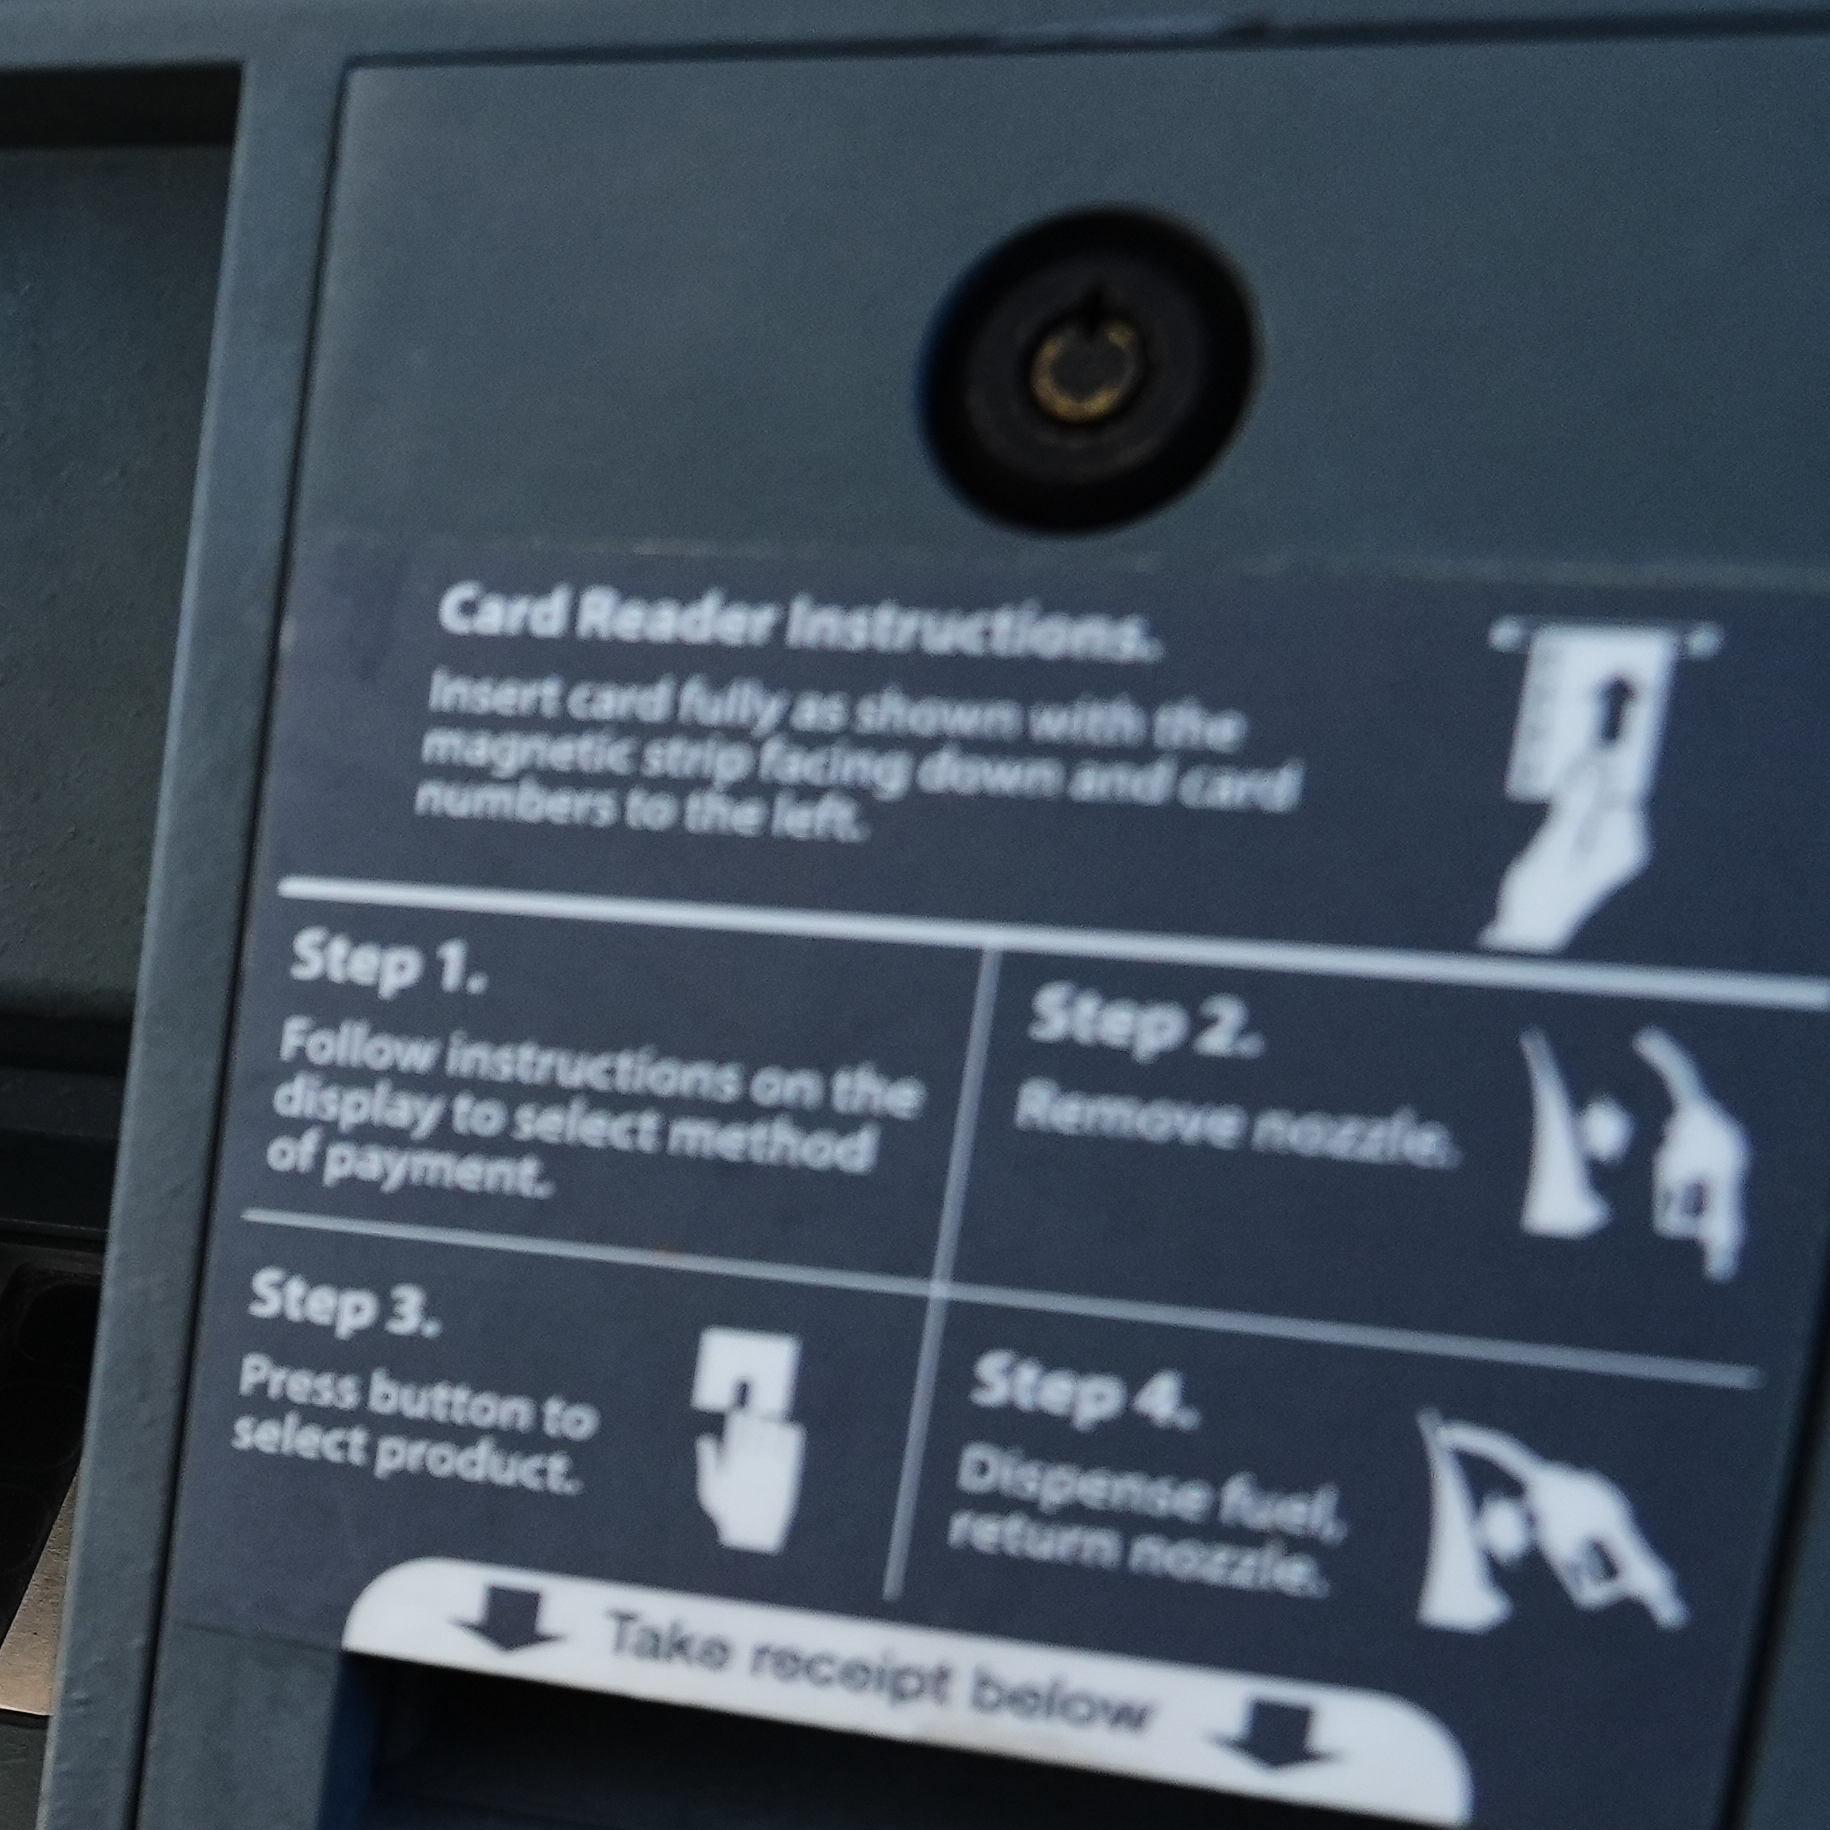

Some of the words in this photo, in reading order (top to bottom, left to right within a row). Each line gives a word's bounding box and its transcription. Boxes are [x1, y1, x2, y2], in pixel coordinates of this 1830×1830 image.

[439, 581, 573, 639] Card
[575, 585, 782, 647] Reader
[786, 593, 1165, 664] Instructions.
[429, 664, 564, 718] Insert
[566, 672, 676, 724] card
[677, 673, 792, 739] fully
[788, 690, 849, 732] as
[851, 682, 1025, 741] shown
[1028, 691, 1147, 748] with
[1151, 693, 1248, 754] the
[414, 774, 620, 828] numbers
[623, 785, 681, 831] to
[682, 787, 768, 838] the
[769, 789, 870, 842] left.
[420, 725, 638, 779] magnetic
[639, 731, 756, 790] strip
[758, 733, 913, 801] facing
[914, 740, 1067, 797] down
[1067, 751, 1179, 807] and
[1177, 756, 1306, 815] card
[290, 926, 424, 1000] Step
[435, 937, 489, 996] 1.
[279, 1014, 439, 1074] Follow
[443, 1029, 743, 1102] instructions
[749, 1064, 823, 1111] on
[829, 1060, 927, 1120] the
[1027, 979, 1191, 1065] Step
[1192, 992, 1267, 1060] 2.
[264, 1124, 324, 1174] of
[322, 1136, 555, 1201] payment.
[272, 1070, 446, 1140] display
[451, 1089, 507, 1137] to
[511, 1094, 662, 1155] select
[667, 1112, 882, 1176] method
[1012, 1074, 1247, 1151] Remove
[1249, 1102, 1465, 1172] nozzle.
[246, 1265, 381, 1340] Step
[384, 1282, 442, 1339] 3.
[238, 1351, 362, 1411] Press
[366, 1364, 538, 1434] button
[541, 1393, 601, 1442] to
[967, 1348, 1128, 1433] Step
[1130, 1366, 1203, 1432] 4.
[230, 1409, 370, 1468] select
[373, 1434, 585, 1497] product.
[955, 1440, 1217, 1524] Dispense
[1217, 1470, 1349, 1546] fuel,
[947, 1509, 1125, 1574] return
[1127, 1531, 1331, 1600] nozzle.
[605, 1607, 732, 1672] Take
[749, 1640, 958, 1711] receipt
[969, 1661, 1158, 1736] below
